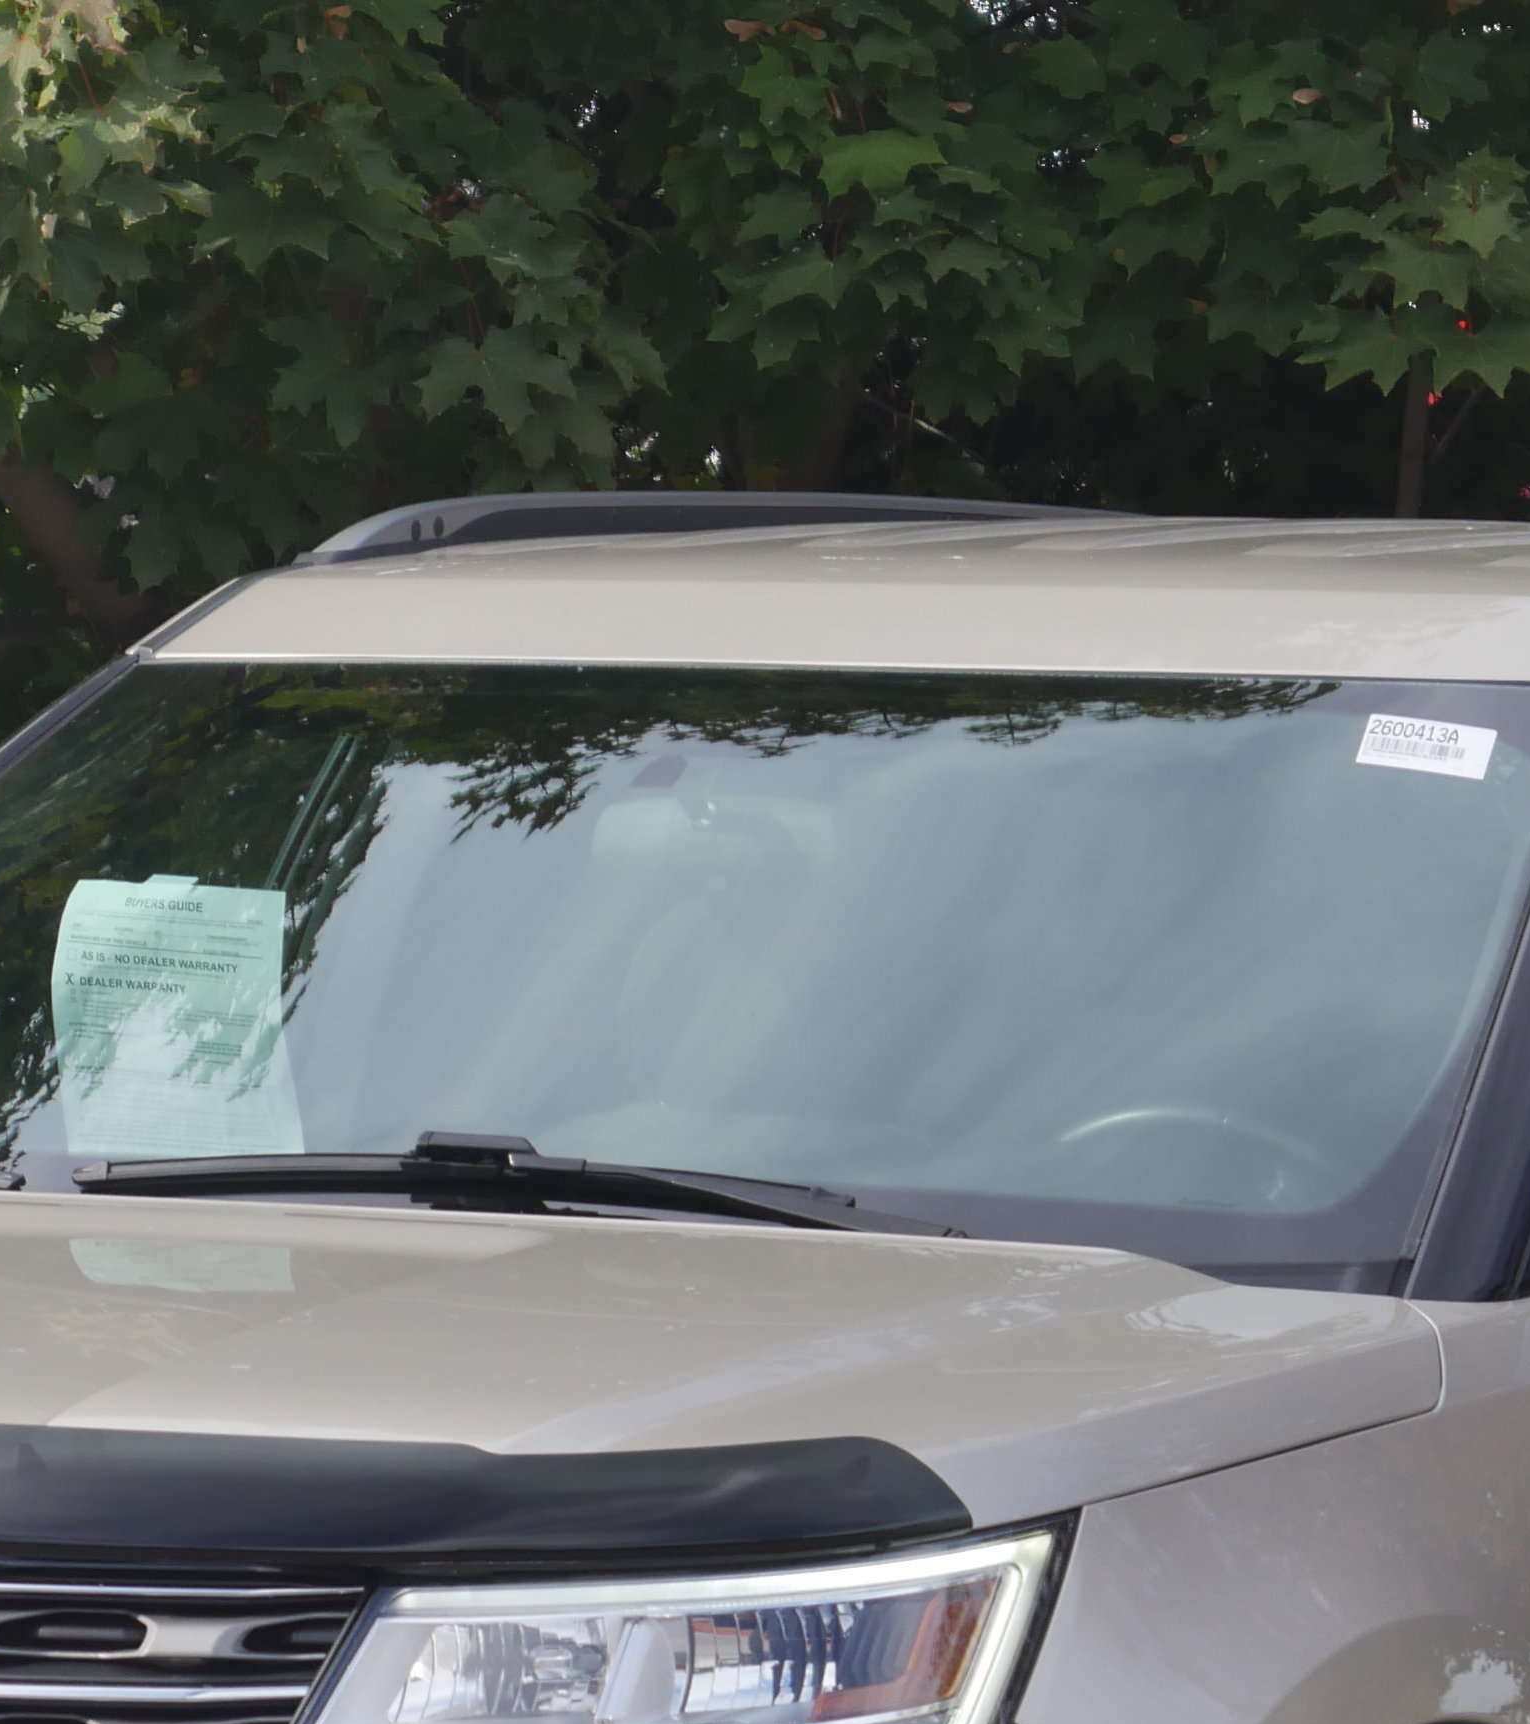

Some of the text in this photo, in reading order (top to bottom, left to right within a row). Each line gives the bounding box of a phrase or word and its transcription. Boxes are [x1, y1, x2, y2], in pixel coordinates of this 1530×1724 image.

[1369, 719, 1459, 744] 2600413A
[125, 897, 203, 913] BUYERS GUIDE
[81, 950, 94, 961] AS
[96, 951, 105, 962] IS
[114, 954, 130, 964] NO
[133, 955, 176, 968] DEALER
[178, 959, 238, 973] WARRANTY
[80, 976, 123, 989] DEALER
[125, 980, 186, 994] WARRANTY
